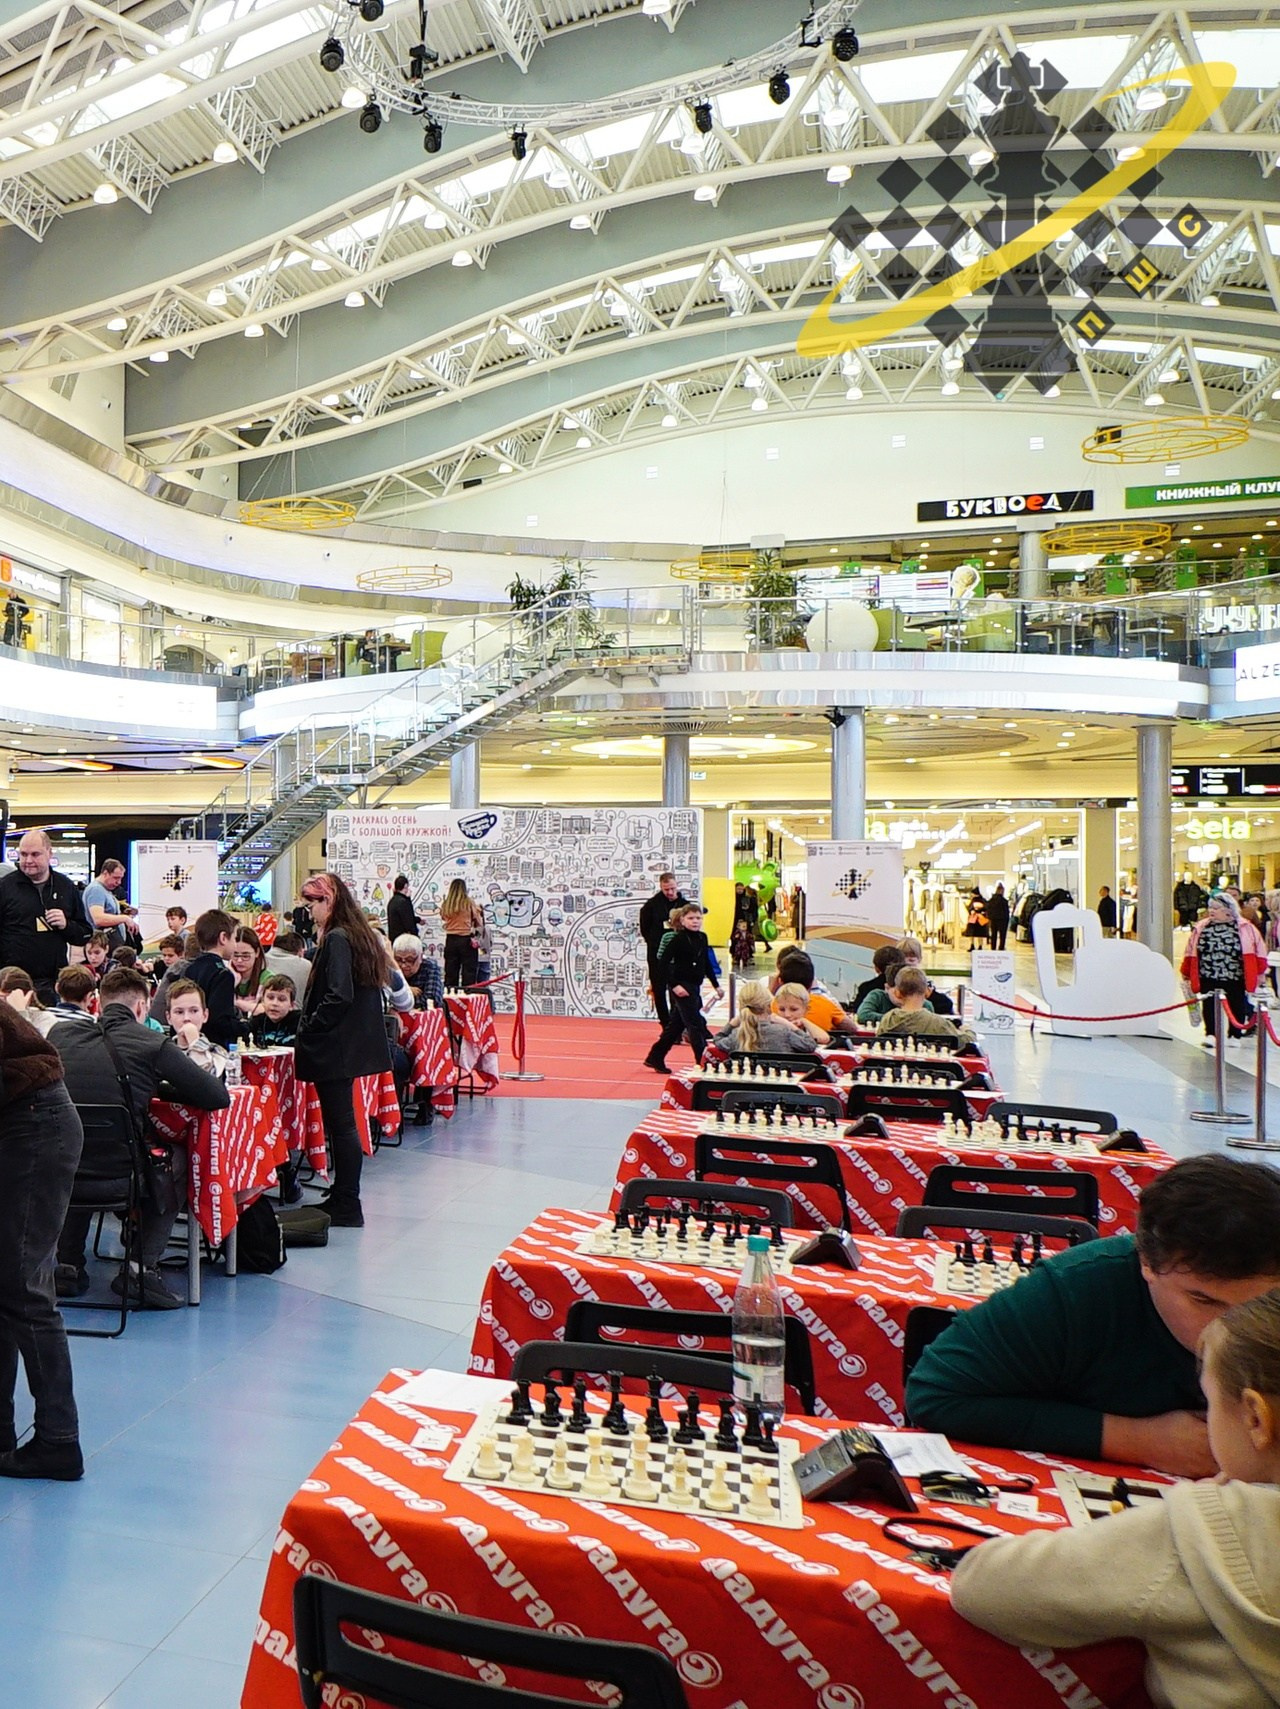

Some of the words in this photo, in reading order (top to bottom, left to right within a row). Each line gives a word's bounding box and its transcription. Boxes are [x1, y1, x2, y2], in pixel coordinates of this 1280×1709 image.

[1156, 482, 1241, 500] КНИЖНЫЙ
[352, 815, 388, 825] РАСКРАСЬ
[392, 815, 417, 824] ОСЕНЬ
[359, 825, 402, 837] БОЛЬШОЙ
[406, 825, 452, 837] КРУЖКОЙ!
[1185, 816, 1251, 840] sela
[324, 1496, 430, 1599] радуга
[442, 1515, 555, 1628] радуга
[567, 1534, 689, 1657] радуга
[699, 1557, 831, 1691] радуга
